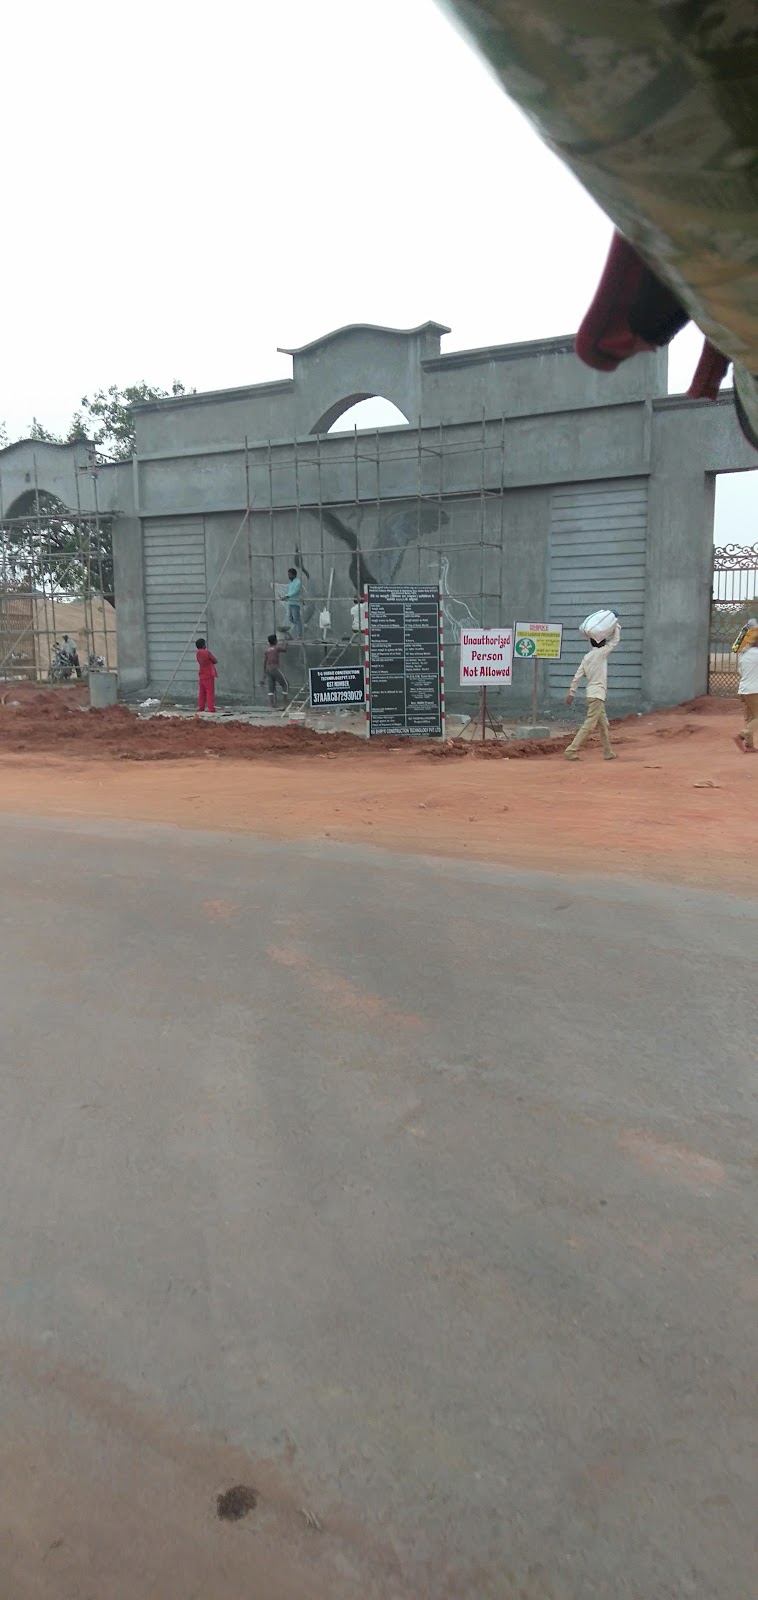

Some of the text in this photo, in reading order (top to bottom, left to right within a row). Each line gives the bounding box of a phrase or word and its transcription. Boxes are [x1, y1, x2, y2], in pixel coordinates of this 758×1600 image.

[463, 635, 510, 648] Unauthorized
[471, 650, 503, 661] Person
[463, 666, 510, 677] Not Allowed
